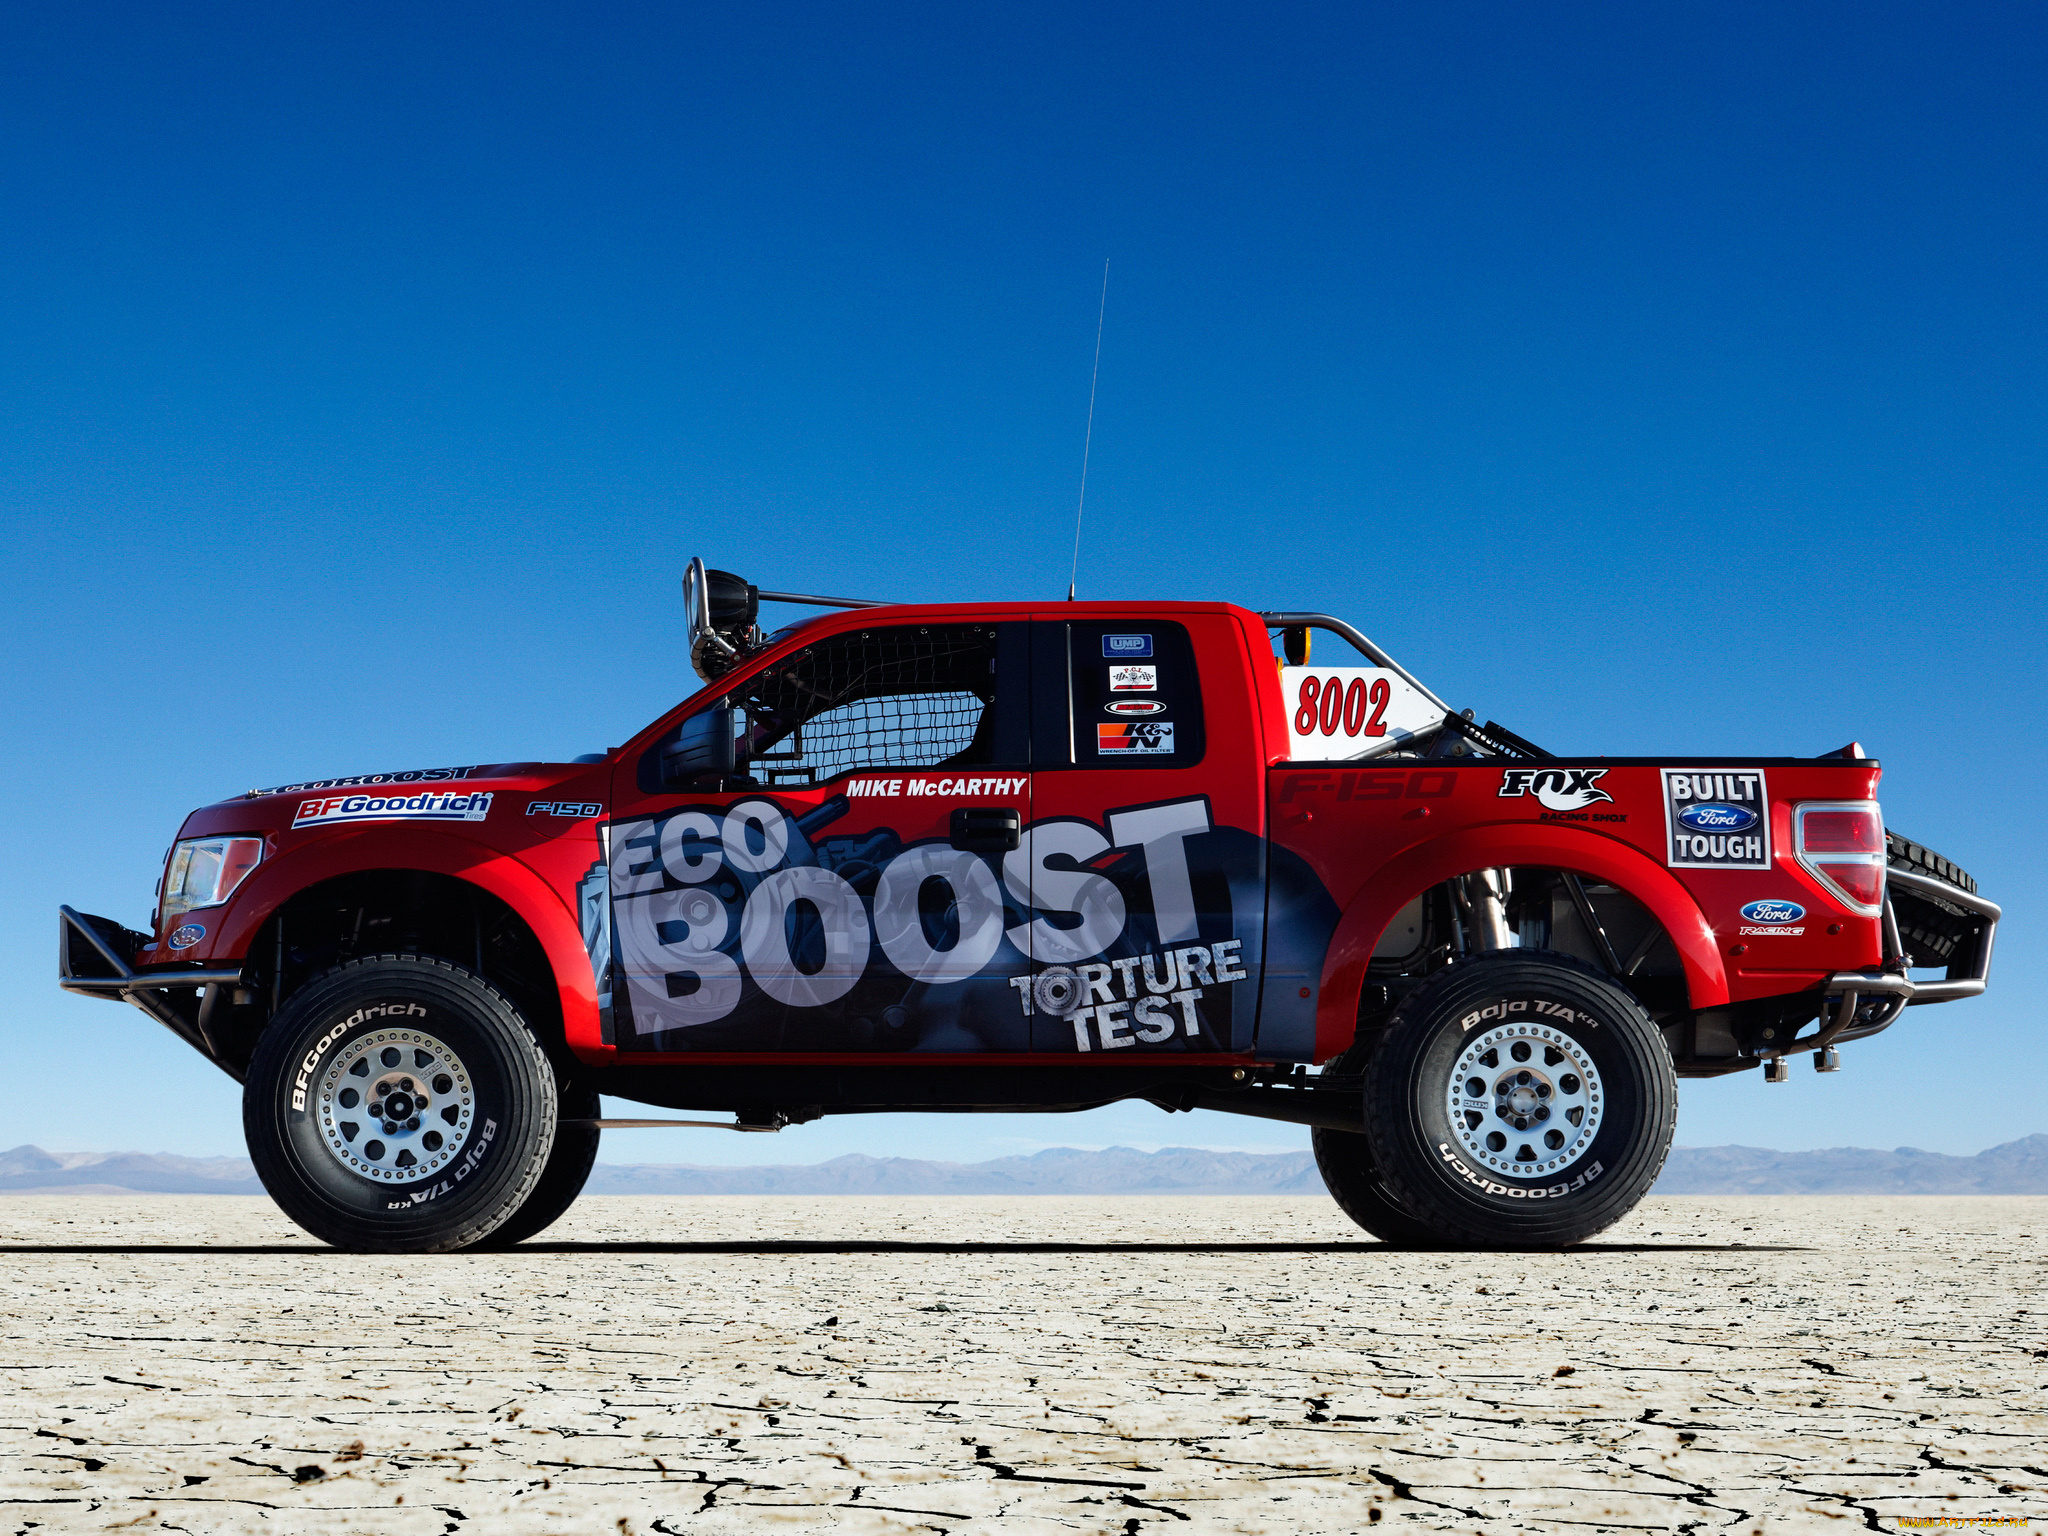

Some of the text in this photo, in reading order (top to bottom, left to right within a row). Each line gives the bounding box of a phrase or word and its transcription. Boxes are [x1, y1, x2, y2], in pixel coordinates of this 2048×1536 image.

[1113, 638, 1142, 648] UMP
[1295, 675, 1391, 737] 8002
[846, 778, 1027, 797] MIKE McCARTHY
[1279, 771, 1458, 804] F-150
[1497, 769, 1610, 798] FOX
[1670, 775, 1758, 800] BUILT
[296, 792, 490, 820] BFGoodrich
[465, 812, 484, 820] Tires
[525, 801, 603, 818] F-150
[1540, 812, 1628, 822] RACING SHOX
[1697, 808, 1738, 826] Ford
[602, 800, 788, 897] ECO
[1675, 834, 1762, 859] TOUGH
[613, 799, 1211, 1035] BOOST
[1752, 904, 1793, 921] Ford
[1739, 926, 1806, 936] RACING
[1009, 938, 1248, 1017] TORTURE
[1062, 987, 1204, 1053] TEST
[1460, 1000, 1528, 1032] Baja
[291, 1002, 427, 1113] BFGoodrich
[454, 1117, 497, 1181] Baja
[1438, 1142, 1605, 1199] BFGoodrich
